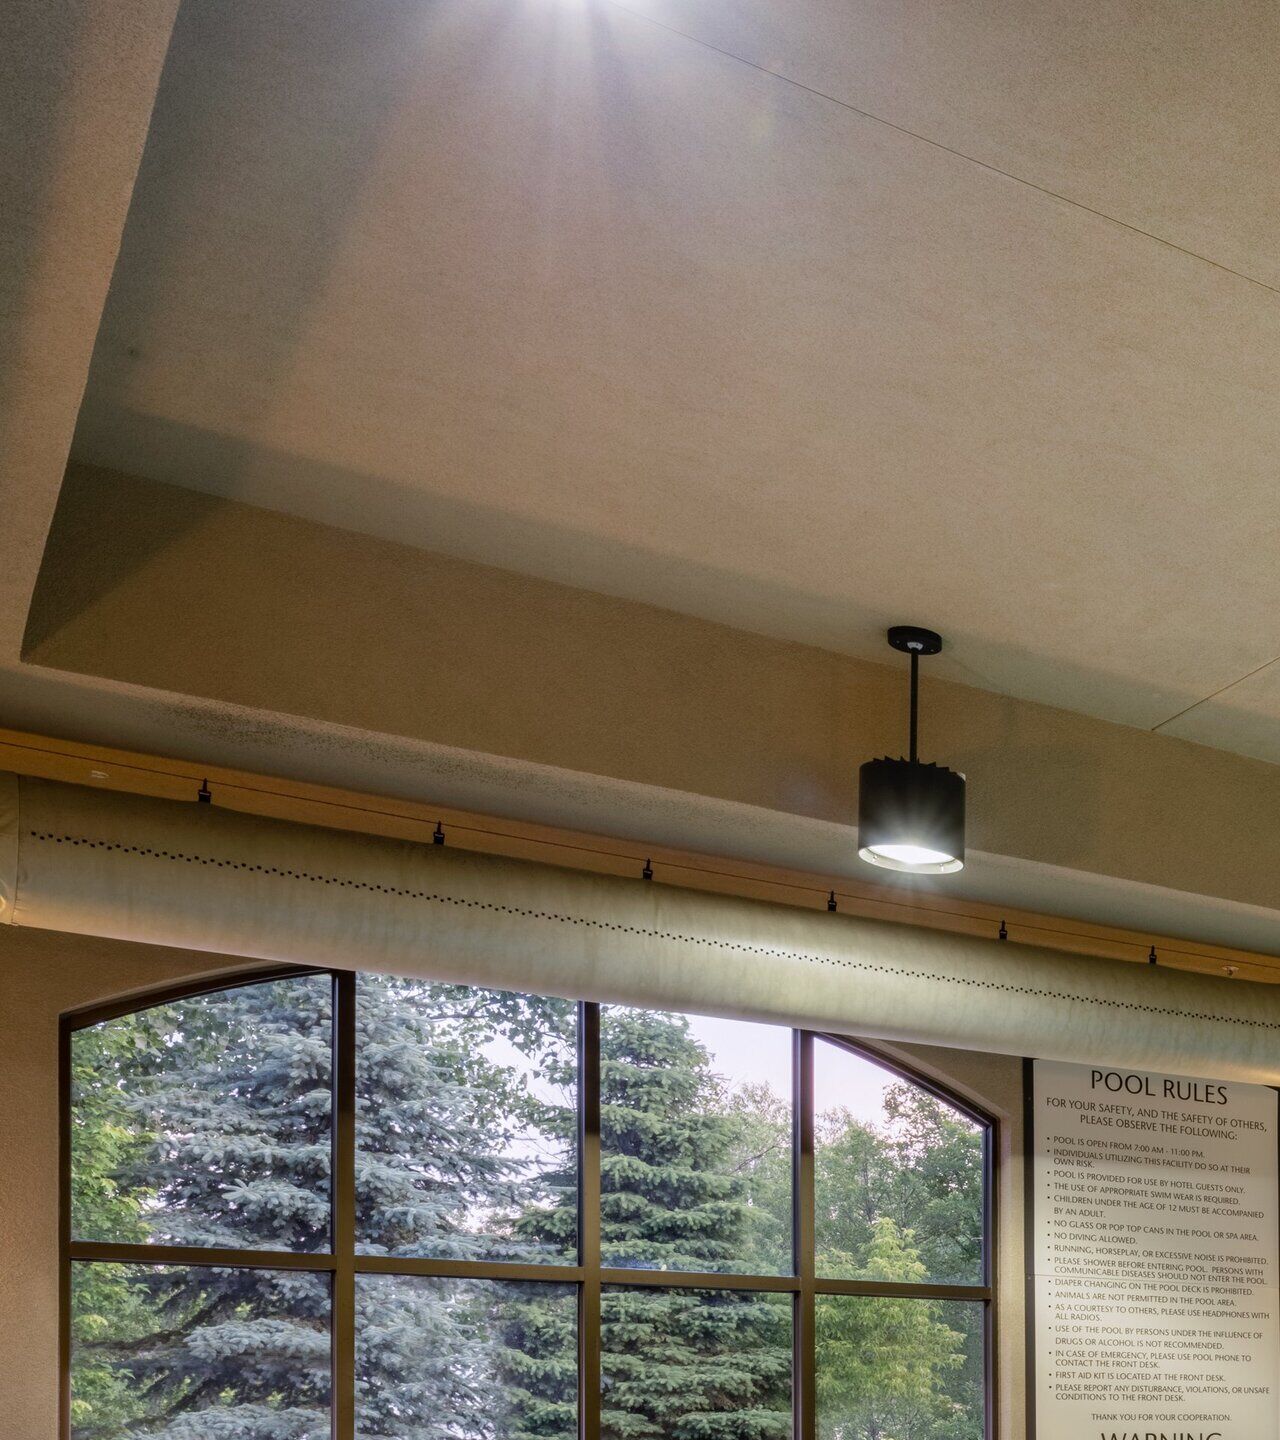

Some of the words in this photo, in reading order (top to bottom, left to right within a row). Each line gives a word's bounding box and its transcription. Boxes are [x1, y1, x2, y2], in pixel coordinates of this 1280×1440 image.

[1091, 1070, 1155, 1097] POOL
[1163, 1078, 1227, 1105] RULES
[1046, 1097, 1067, 1108] FOR
[1068, 1099, 1096, 1111] YOUR
[1098, 1103, 1134, 1117] SAFETY,
[1136, 1107, 1158, 1119] AND
[1161, 1110, 1178, 1121] THE
[1180, 1113, 1213, 1125] SAFETY
[1214, 1117, 1227, 1127] OF
[1229, 1118, 1267, 1133] OTHERS,
[1079, 1114, 1113, 1127] PLEASE
[1115, 1118, 1157, 1132] OBSERVE
[1160, 1123, 1177, 1134] THE
[1179, 1125, 1237, 1140] FOLLOWING:
[1053, 1135, 1075, 1145] POOL
[1077, 1138, 1084, 1146] IS
[1085, 1139, 1108, 1148] OPEN
[1109, 1141, 1132, 1150] FROM
[1133, 1143, 1150, 1152] 7:00
[1150, 1145, 1164, 1154] AM
[1170, 1147, 1190, 1156] 11:00
[1053, 1148, 1103, 1160] INDIVIDUALS
[1104, 1153, 1142, 1164] UTILIZING
[1143, 1156, 1161, 1165] THIS
[1162, 1158, 1193, 1168] FACILITY
[1194, 1161, 1207, 1170] DO
[1207, 1163, 1219, 1171] SO
[1219, 1164, 1229, 1172] AT
[1230, 1165, 1250, 1174] THEIR
[1053, 1158, 1074, 1167] OWN
[1053, 1170, 1076, 1179] POOL
[1077, 1172, 1084, 1180] IS
[1086, 1172, 1126, 1183] PROVIDED
[1126, 1176, 1142, 1185] FOR
[1143, 1177, 1157, 1186] USE
[1159, 1179, 1169, 1187] BY
[1169, 1180, 1194, 1189] HOTEL
[1195, 1182, 1224, 1192] GUESTS
[1053, 1194, 1093, 1205] CHILDREN
[1094, 1198, 1121, 1207] UNDER
[1123, 1200, 1137, 1208] THE
[1138, 1201, 1154, 1210] AGE
[1155, 1203, 1166, 1211] OF
[1168, 1204, 1177, 1212] 12
[1178, 1204, 1199, 1213] MUST
[1201, 1206, 1210, 1214] BE
[1211, 1207, 1264, 1218] ACCOMPANIED
[1053, 1207, 1063, 1215] BY
[1064, 1208, 1077, 1216] AN
[1053, 1232, 1067, 1240] NO
[1068, 1233, 1097, 1242] DIVING
[1141, 1249, 1153, 1257] OR
[1154, 1250, 1193, 1260] EXCESSIVE
[1193, 1253, 1216, 1261] NOISE
[1217, 1254, 1224, 1262] IS
[1053, 1256, 1081, 1265] PLEASE
[1082, 1258, 1116, 1267] SHOWER
[1117, 1260, 1145, 1269] BEFORE
[1146, 1262, 1184, 1271] ENTERING
[1211, 1265, 1243, 1274] PERSONS
[1244, 1267, 1263, 1276] WITH
[1054, 1303, 1065, 1311] AS
[1073, 1304, 1113, 1313] COURTESY
[1116, 1306, 1126, 1314] TO
[1160, 1308, 1185, 1316] PLEASE
[1186, 1309, 1201, 1317] USE
[1202, 1310, 1250, 1319] HEADPHONES
[1250, 1312, 1270, 1320] WITH
[1054, 1312, 1068, 1320] ALL
[1055, 1337, 1084, 1345] DRUGS
[1097, 1338, 1135, 1347] ALCOHOL
[1145, 1340, 1162, 1348] NOT
[1055, 1350, 1064, 1358] IN
[1065, 1350, 1085, 1358] CASE
[1149, 1352, 1176, 1360] PLEASE
[1192, 1353, 1213, 1361] POOL
[1214, 1354, 1239, 1362] PHONE
[1241, 1354, 1251, 1362] TO
[1054, 1359, 1092, 1367] CONTACT
[1111, 1360, 1137, 1368] FRONT
[1055, 1371, 1075, 1379] FIRST
[1107, 1372, 1114, 1380] IS
[1115, 1372, 1151, 1380] LOCATED
[1164, 1373, 1177, 1381] THE
[1179, 1373, 1204, 1381] FRONT
[1055, 1384, 1081, 1392] PLEASE
[1083, 1384, 1111, 1392] REPORT
[1231, 1386, 1242, 1394] OR
[1243, 1386, 1269, 1394] UNSAFE
[1055, 1393, 1106, 1401] CONDITIONS
[1108, 1393, 1120, 1401] TO
[1121, 1393, 1135, 1401] THE
[1119, 1413, 1136, 1421] YOU
[1137, 1413, 1153, 1421] FOR
[1154, 1413, 1176, 1421] YOUR
